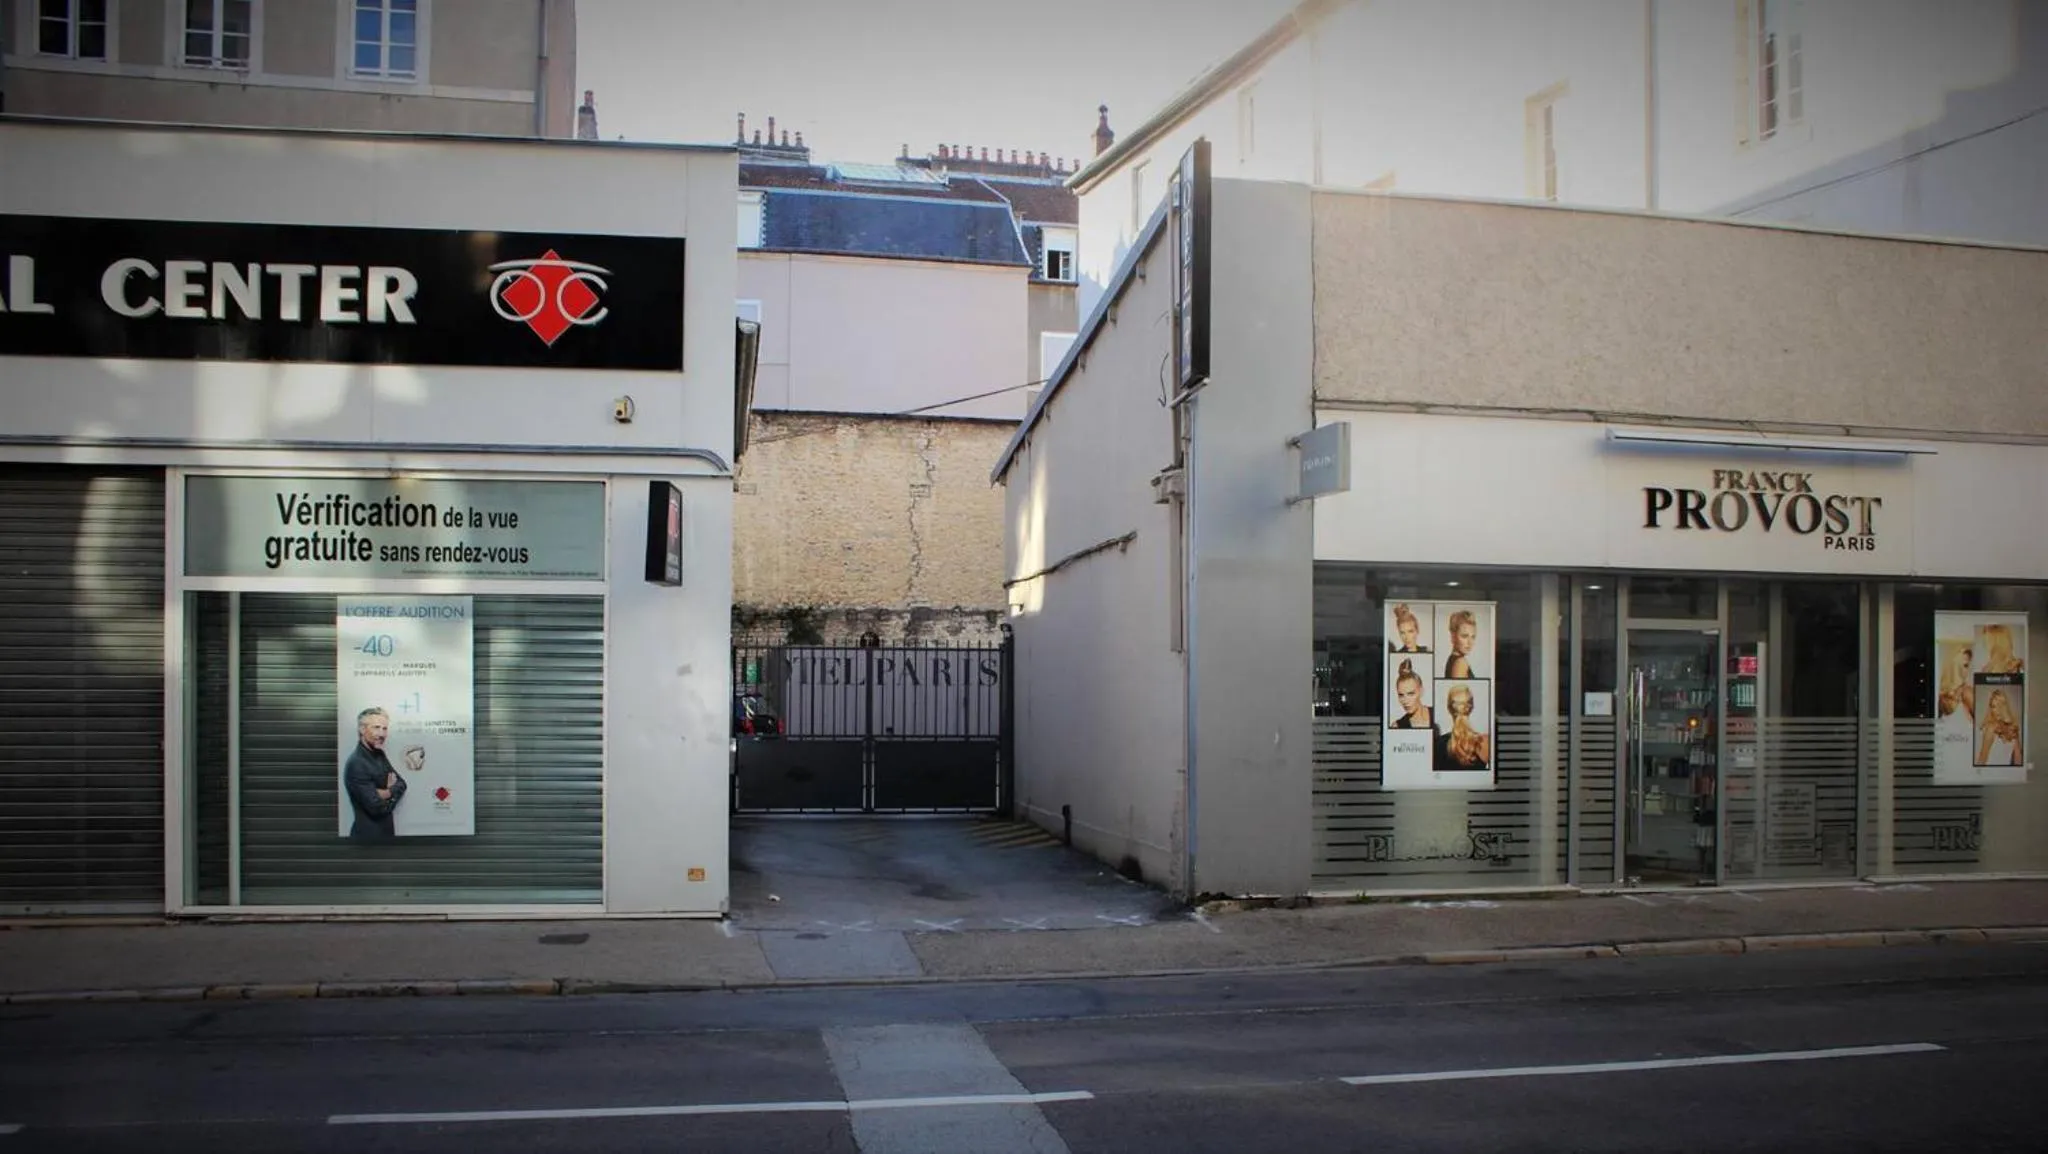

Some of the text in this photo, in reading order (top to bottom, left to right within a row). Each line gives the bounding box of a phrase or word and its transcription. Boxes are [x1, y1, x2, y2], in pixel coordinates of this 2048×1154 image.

[0, 254, 419, 324] L CENTER
[1712, 469, 1813, 493] FRANCK
[276, 492, 519, 529] Vérification de la vue
[1642, 487, 1883, 536] PROVOST
[264, 529, 529, 569] gratuite sans rendez-vous
[1823, 536, 1876, 551] PARIS
[345, 605, 465, 619] L'OFFRE AUDITION
[874, 657, 998, 687] PARIS
